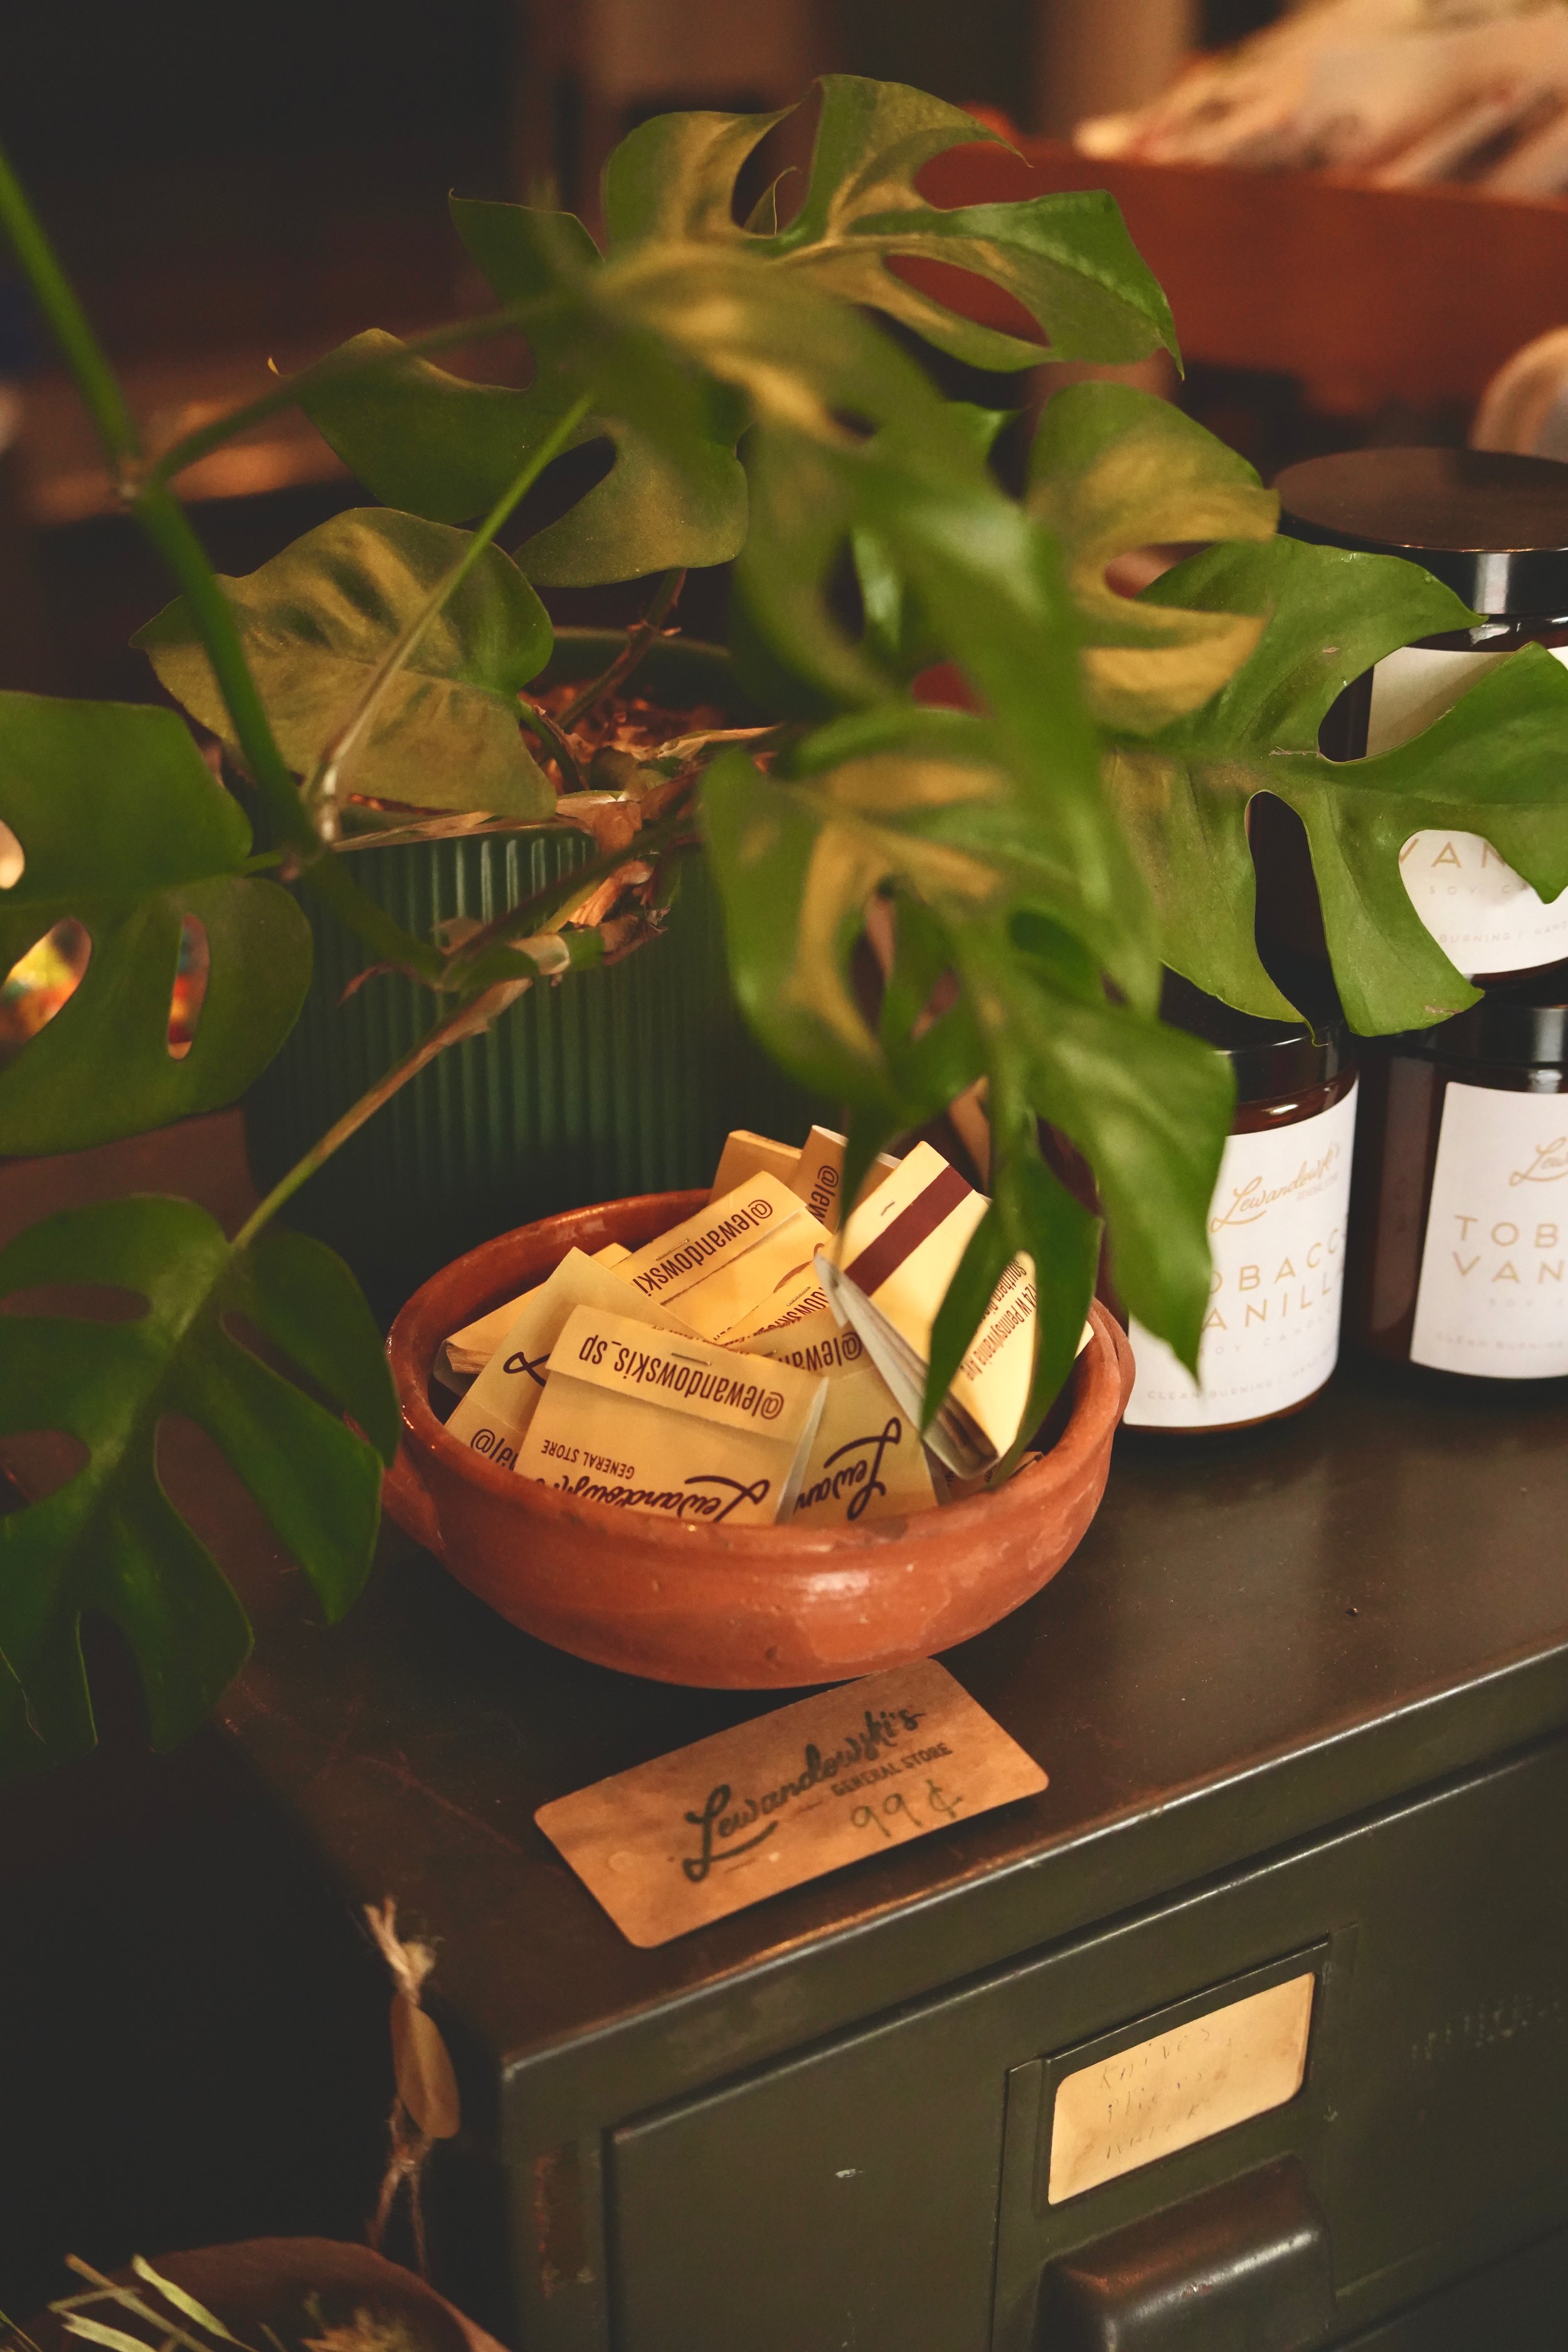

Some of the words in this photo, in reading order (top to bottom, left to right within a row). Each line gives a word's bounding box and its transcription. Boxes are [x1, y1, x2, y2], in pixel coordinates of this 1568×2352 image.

[972, 1305, 1024, 1365] Pennsylvania
[1014, 1297, 1032, 1317] W
[578, 1333, 785, 1420] @lewandowskis_sp
[541, 1439, 578, 1463] STORE
[583, 1453, 635, 1480] GENERAL
[682, 1706, 926, 1882] Lewandowski's
[832, 1759, 901, 1798] GENERAL
[905, 1741, 953, 1771] STORE
